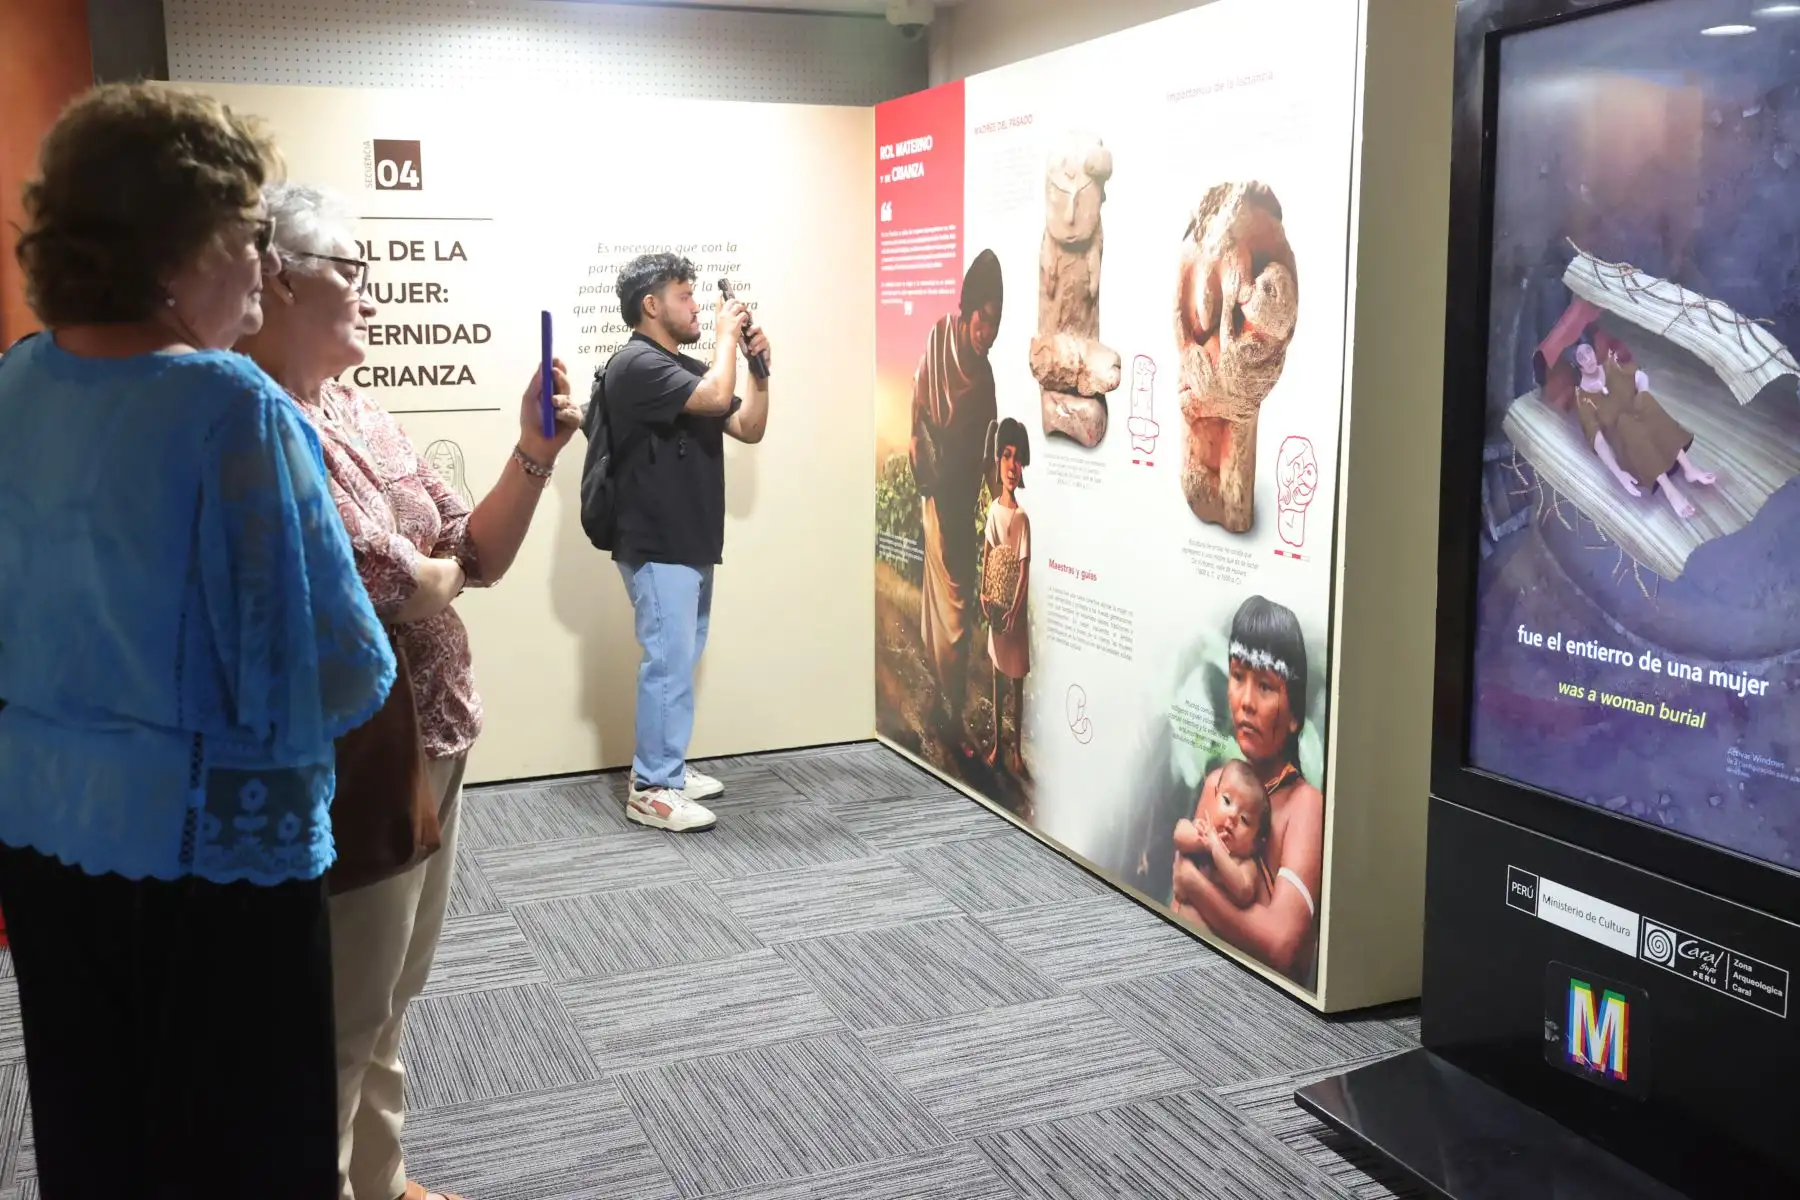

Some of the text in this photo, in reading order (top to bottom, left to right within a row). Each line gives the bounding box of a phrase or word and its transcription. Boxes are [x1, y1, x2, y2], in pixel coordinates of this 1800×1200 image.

[880, 135, 933, 160] ROL MATERNO
[363, 140, 373, 189] SECUENCIA
[376, 159, 420, 188] 04
[892, 161, 925, 182] CRIANZA
[389, 240, 425, 261] DE
[435, 240, 468, 261] LA
[598, 241, 738, 256] Es necesario que con la
[707, 262, 742, 274] mujer
[367, 282, 449, 304] UJER:
[702, 281, 713, 292] la
[573, 304, 596, 318] que
[368, 324, 492, 346] ERNIDAD
[581, 325, 597, 334] un
[578, 345, 591, 354] se
[353, 365, 477, 388] CRIANZA
[1048, 558, 1075, 576] Maestras
[1517, 624, 1770, 698] fue el entierro de una mujer
[1558, 681, 1706, 729] was a woman burial
[1511, 881, 1534, 899] PERÚ
[1542, 893, 1631, 937] Ministerio de Cultura
[1677, 939, 1724, 968] Caral
[1733, 958, 1753, 973] Zona
[1692, 970, 1717, 985] PERU
[1732, 971, 1783, 997] Arqueologica
[1732, 983, 1752, 997] Caral
[1564, 978, 1630, 1081] M
